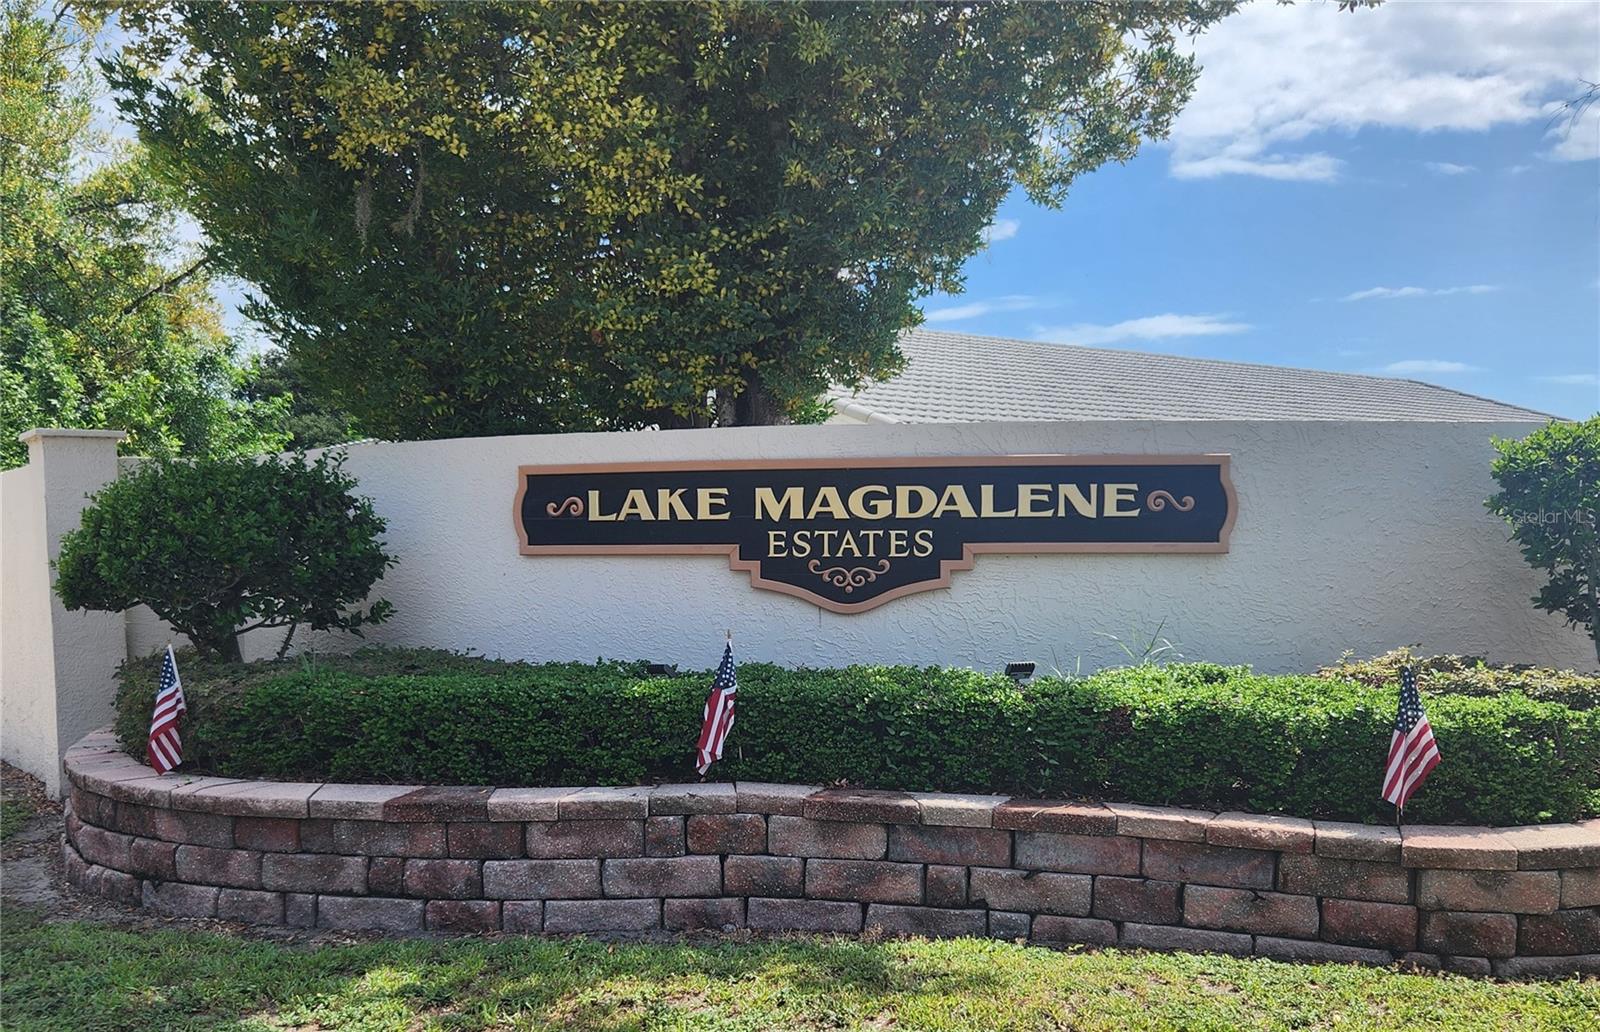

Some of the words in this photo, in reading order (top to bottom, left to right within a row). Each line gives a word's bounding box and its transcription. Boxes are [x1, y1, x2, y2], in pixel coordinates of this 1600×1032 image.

[587, 487, 732, 522] LAKE
[754, 483, 1141, 523] MAGDALENE
[767, 529, 934, 558] ESTATES
